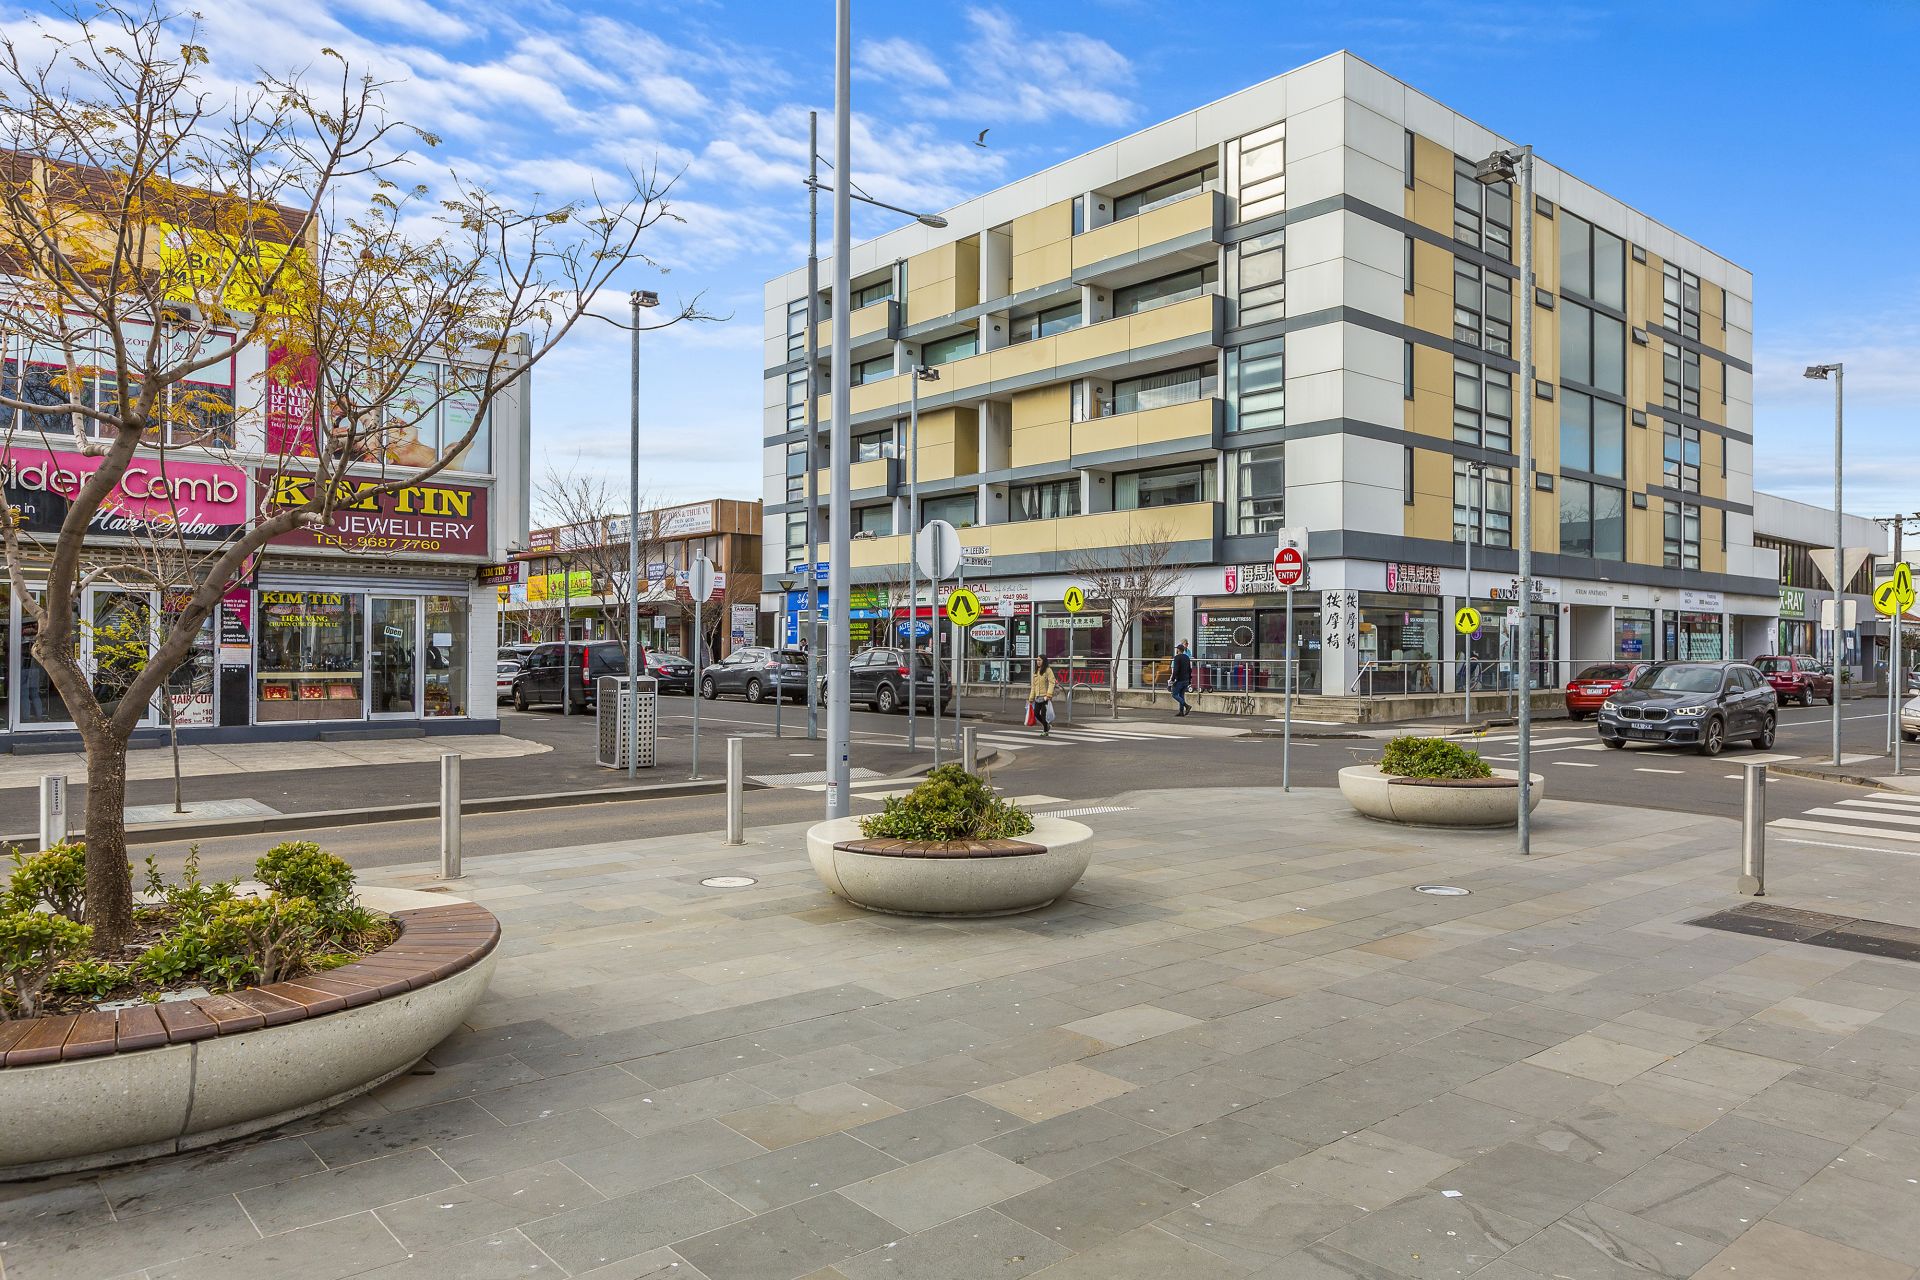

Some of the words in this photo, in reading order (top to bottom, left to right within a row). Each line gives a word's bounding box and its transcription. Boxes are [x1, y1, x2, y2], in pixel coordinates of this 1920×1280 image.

[271, 395, 310, 407] BEAUT
[120, 467, 239, 504] Comb
[271, 475, 379, 511] KM
[386, 485, 472, 517] TIN
[24, 502, 36, 514] in
[338, 515, 475, 540] JEWELLERY
[313, 533, 353, 546] TEL:
[357, 536, 398, 548] 9687
[401, 539, 440, 550] 7760
[972, 557, 988, 565] BYRON
[1284, 552, 1293, 562] NO
[481, 567, 494, 577] KIM
[494, 566, 506, 576] TIN
[1278, 571, 1298, 580] ENTRY
[486, 575, 513, 584] JEWELLERY
[262, 592, 303, 604] KIM
[308, 593, 342, 605] TIN
[1779, 590, 1804, 611] X-RAY
[1326, 592, 1342, 649] 按摩椅
[385, 627, 402, 637] Open
[899, 621, 931, 632] ALTETIONS
[170, 694, 192, 704] HAIR
[195, 693, 212, 704] CUT
[202, 708, 213, 716] $10
